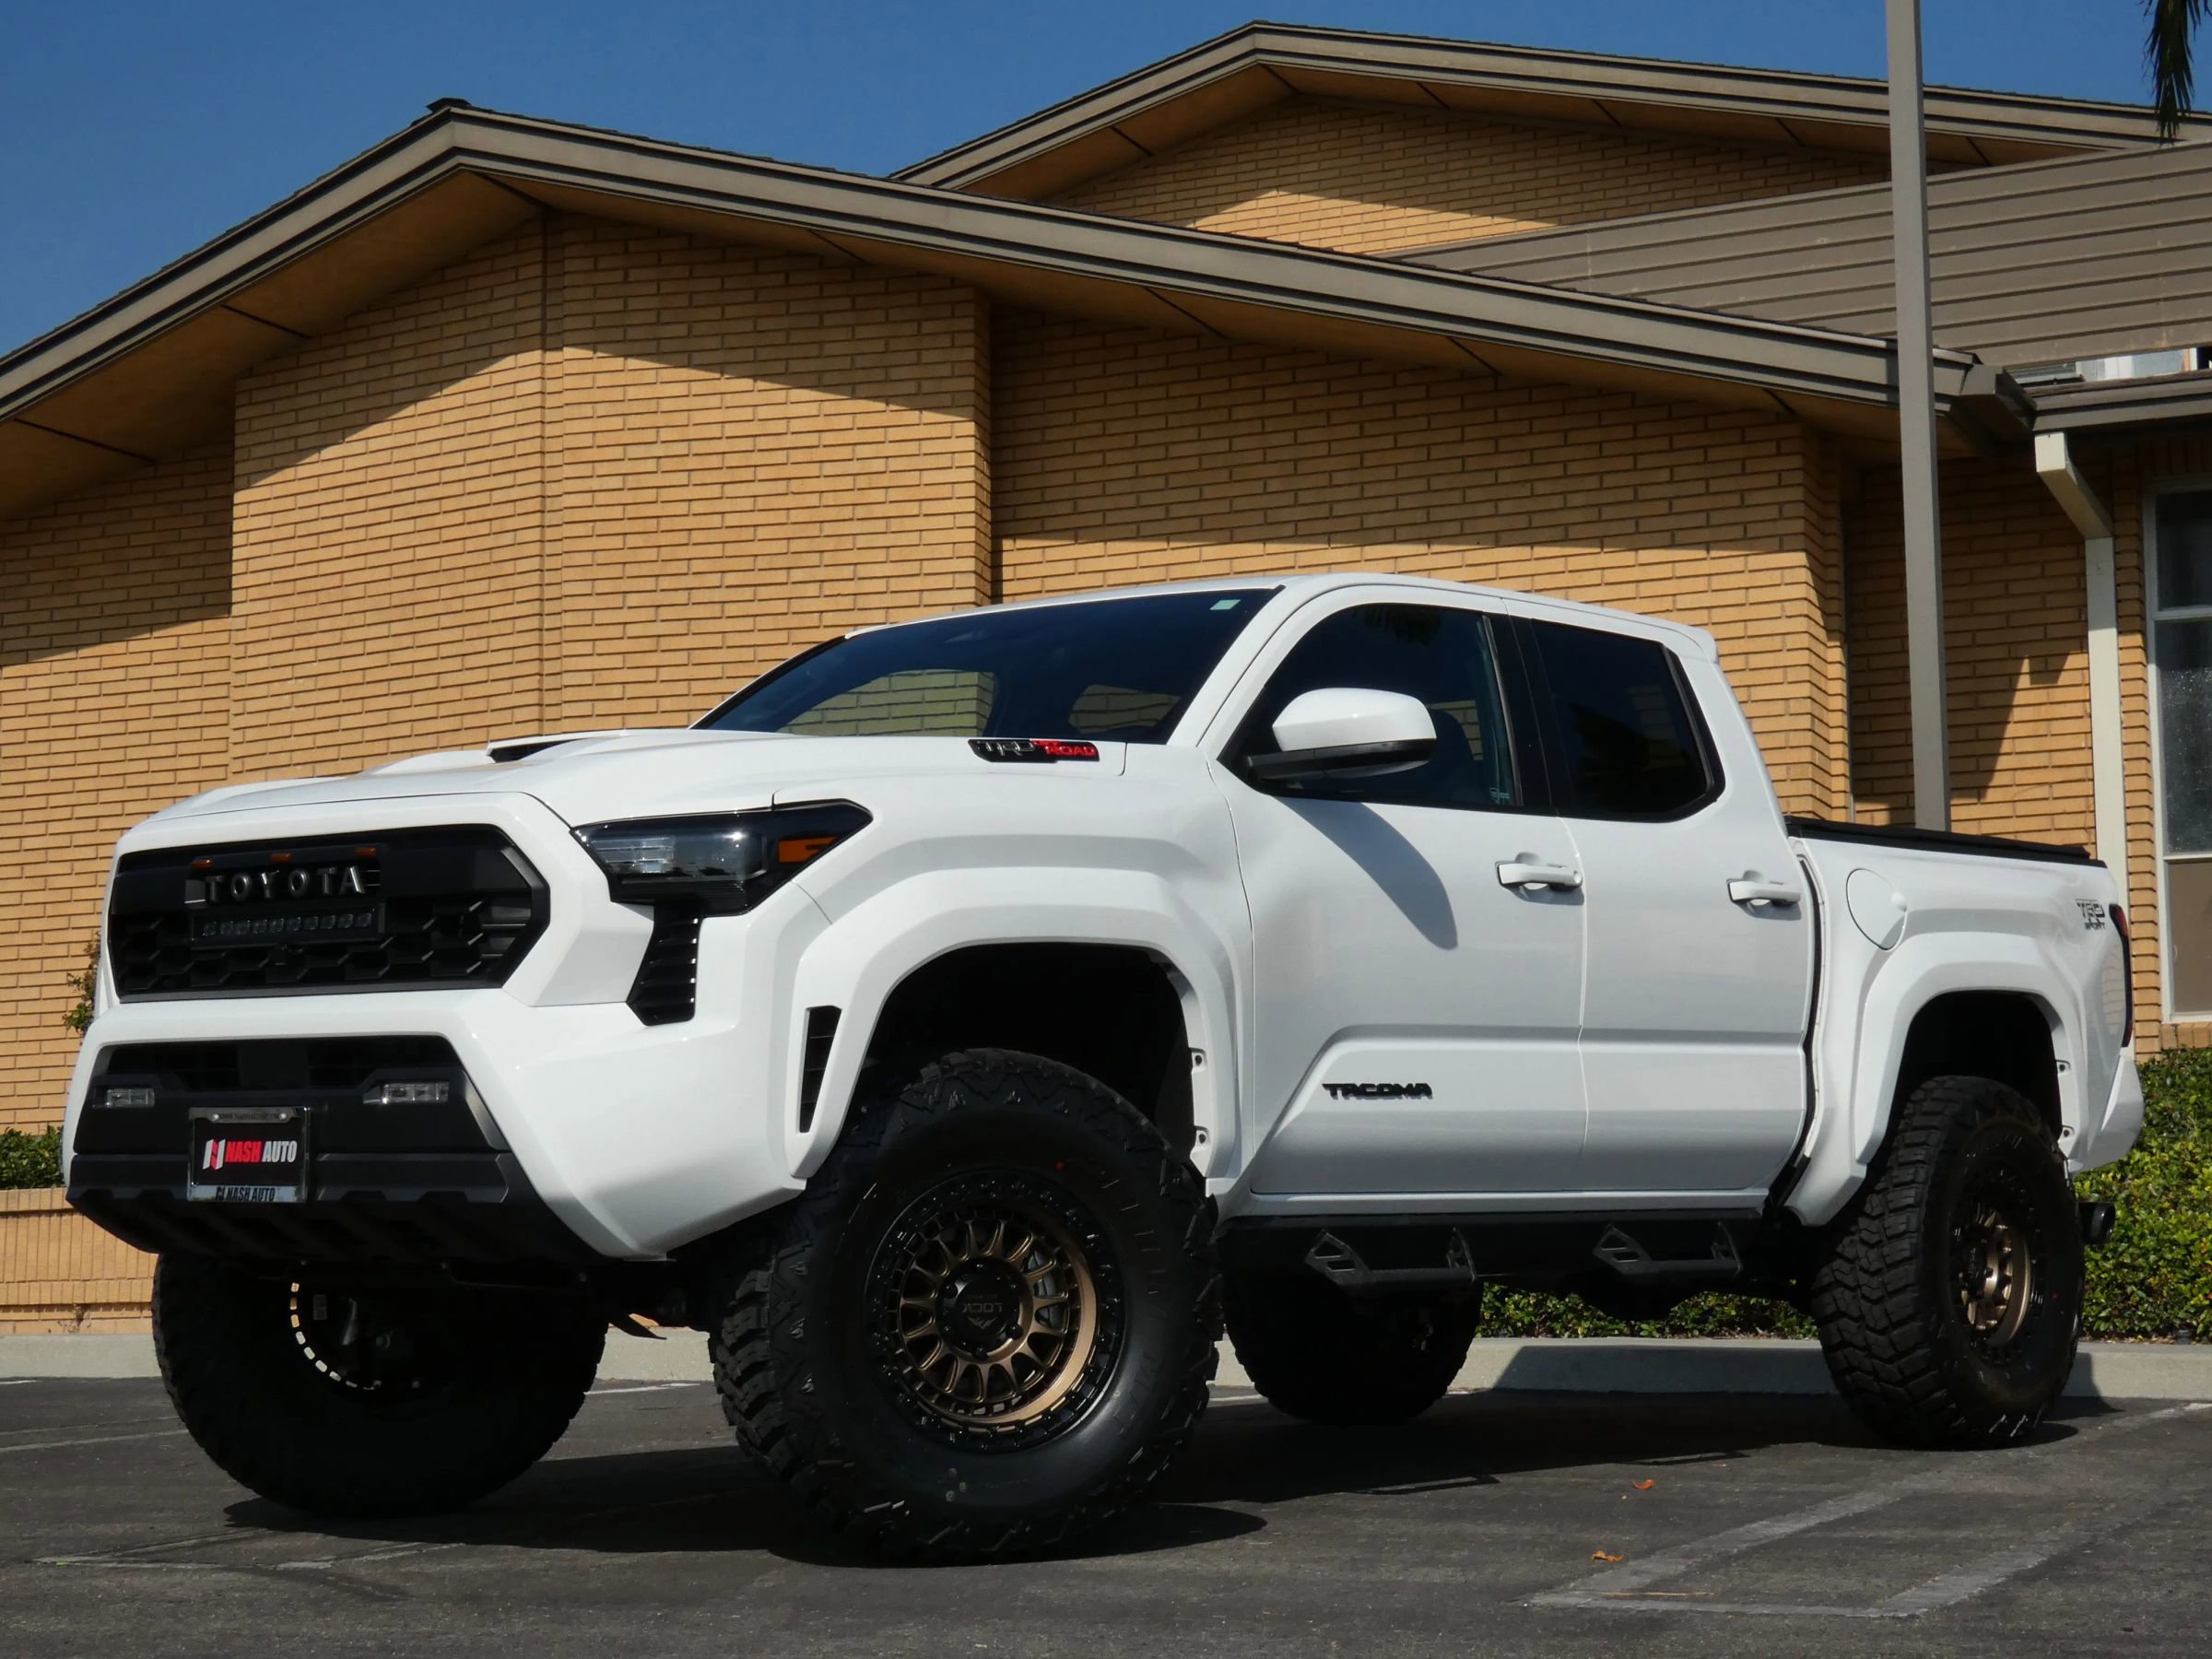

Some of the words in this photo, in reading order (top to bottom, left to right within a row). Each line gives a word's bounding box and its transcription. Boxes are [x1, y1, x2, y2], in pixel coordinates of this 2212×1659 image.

[1045, 745, 1096, 756] ROAD
[206, 866, 365, 902] TOYOTA
[1322, 1083, 1433, 1100] TACOMA
[225, 1140, 262, 1162] NASH
[262, 1140, 298, 1162] AUTO
[226, 1186, 251, 1201] NASH
[252, 1187, 276, 1202] AUTO
